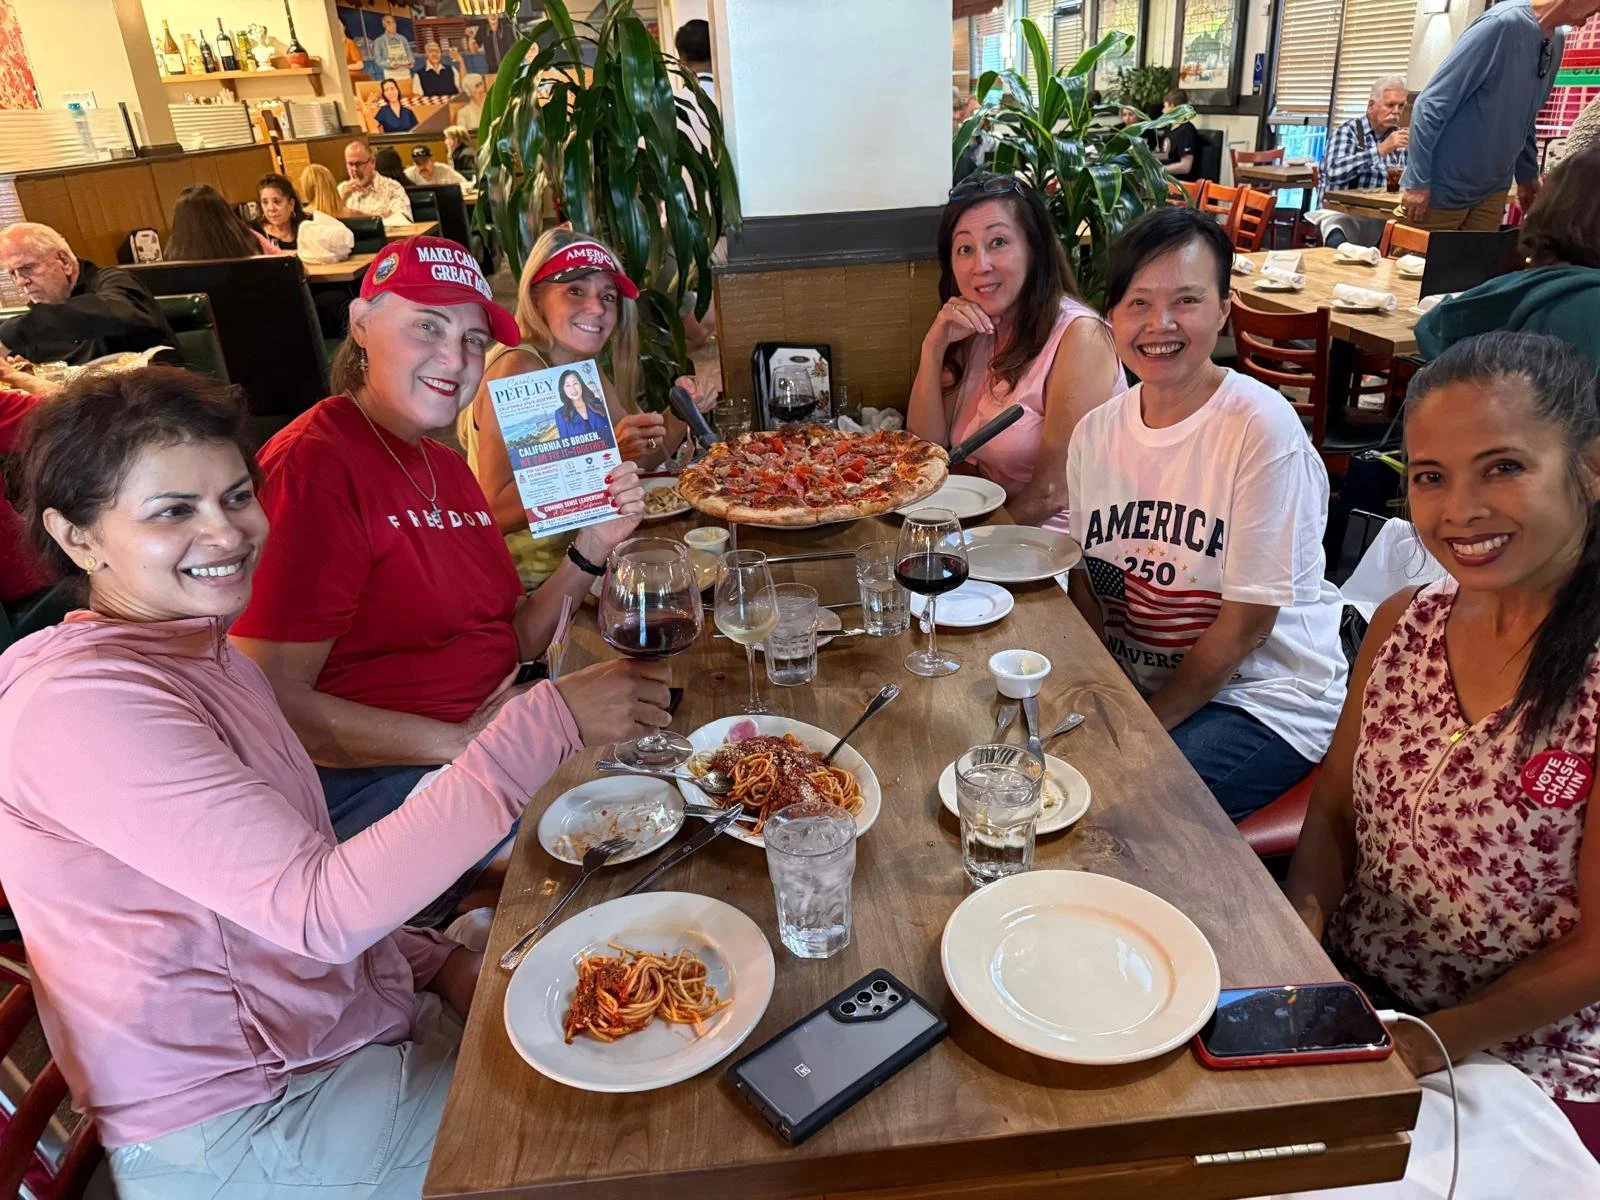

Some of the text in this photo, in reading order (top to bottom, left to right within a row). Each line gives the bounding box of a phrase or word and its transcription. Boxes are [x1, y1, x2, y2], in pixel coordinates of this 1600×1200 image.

[416, 247, 454, 262] MAKE
[431, 264, 474, 288] GREAT
[495, 379, 553, 403] PEFLEY
[519, 431, 601, 458] CALIFORNIA IS BROKEN.
[521, 457, 530, 466] WE
[532, 453, 548, 464] CAN
[549, 450, 560, 461] FIX
[544, 503, 564, 513] COMMON
[564, 499, 578, 508] SENSE
[1085, 500, 1224, 558] AMERICA
[1124, 556, 1176, 586] 250
[1532, 757, 1562, 792] VOTE
[1543, 757, 1579, 804] CHASE
[1560, 770, 1587, 800] WIN
